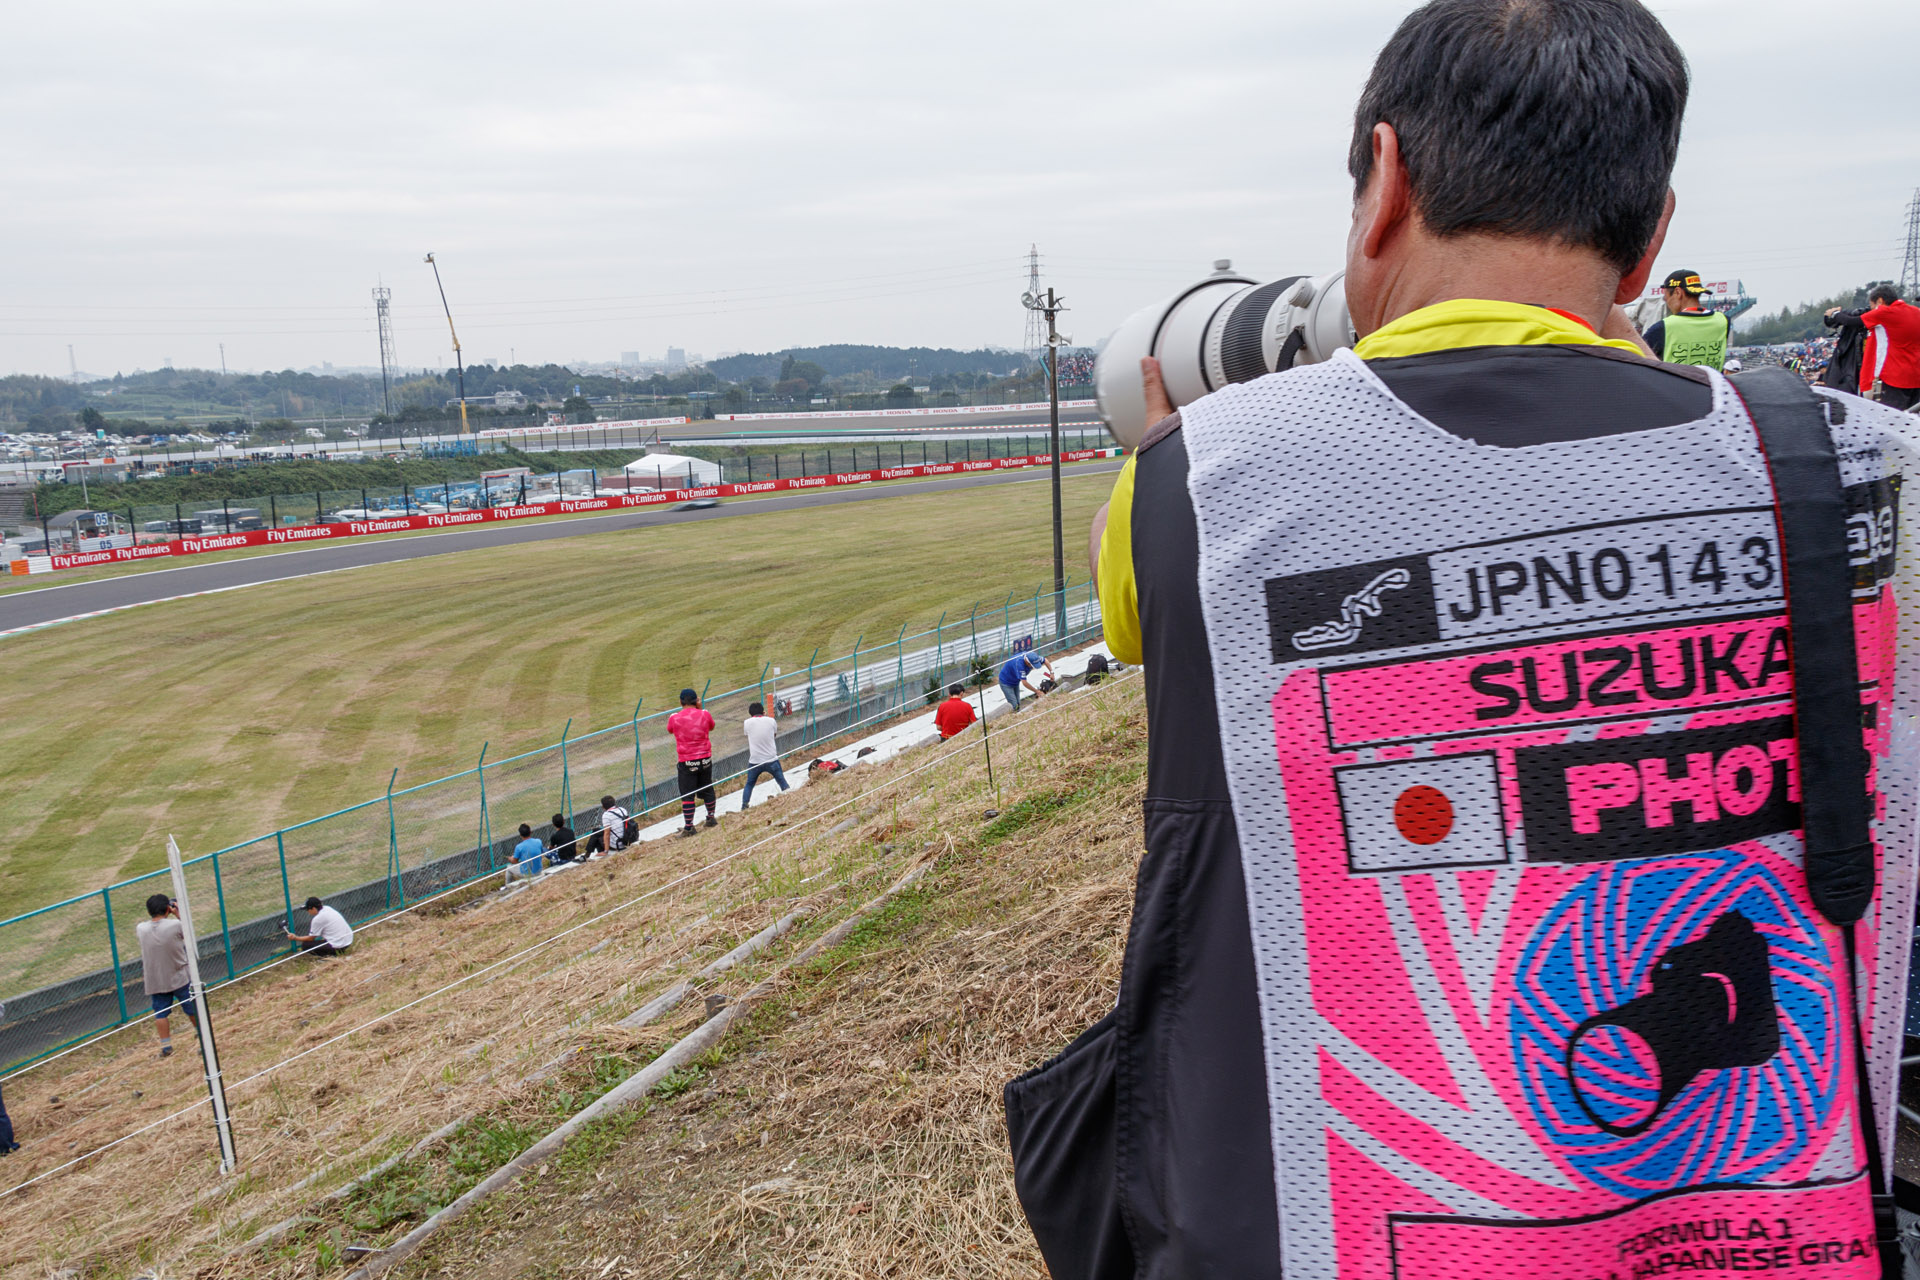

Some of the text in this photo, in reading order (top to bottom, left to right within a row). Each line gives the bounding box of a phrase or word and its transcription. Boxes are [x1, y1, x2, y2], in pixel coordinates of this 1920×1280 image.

[971, 461, 992, 469] Emirates
[1000, 457, 1028, 467] Fly Emirates
[881, 468, 914, 479] Fly Emirates
[923, 464, 954, 474] Fly Emirates
[789, 477, 826, 488] Fly Emirates
[837, 473, 871, 483] Fly Emirates
[676, 487, 718, 500] Fly Emirates
[734, 482, 776, 494] Fly Emirates
[560, 499, 608, 512] Fly Emirates
[622, 493, 667, 506] Fly Emirates
[494, 505, 546, 519] Fly Emirates
[95, 514, 108, 525] 05
[428, 512, 483, 526] Fly Emirates
[351, 519, 410, 534] Fly Emirates
[267, 527, 332, 542] Fly Emirates
[100, 540, 112, 550] 05
[183, 535, 247, 552] Fly Emirates
[116, 545, 170, 559] Fly Emirates
[54, 552, 111, 567] Fly Emirates
[1448, 535, 1775, 623] JPN0143
[1469, 626, 1791, 721] SUZUKA
[1565, 737, 1801, 834] PHOT
[1616, 1218, 1794, 1262] FORMULA 1
